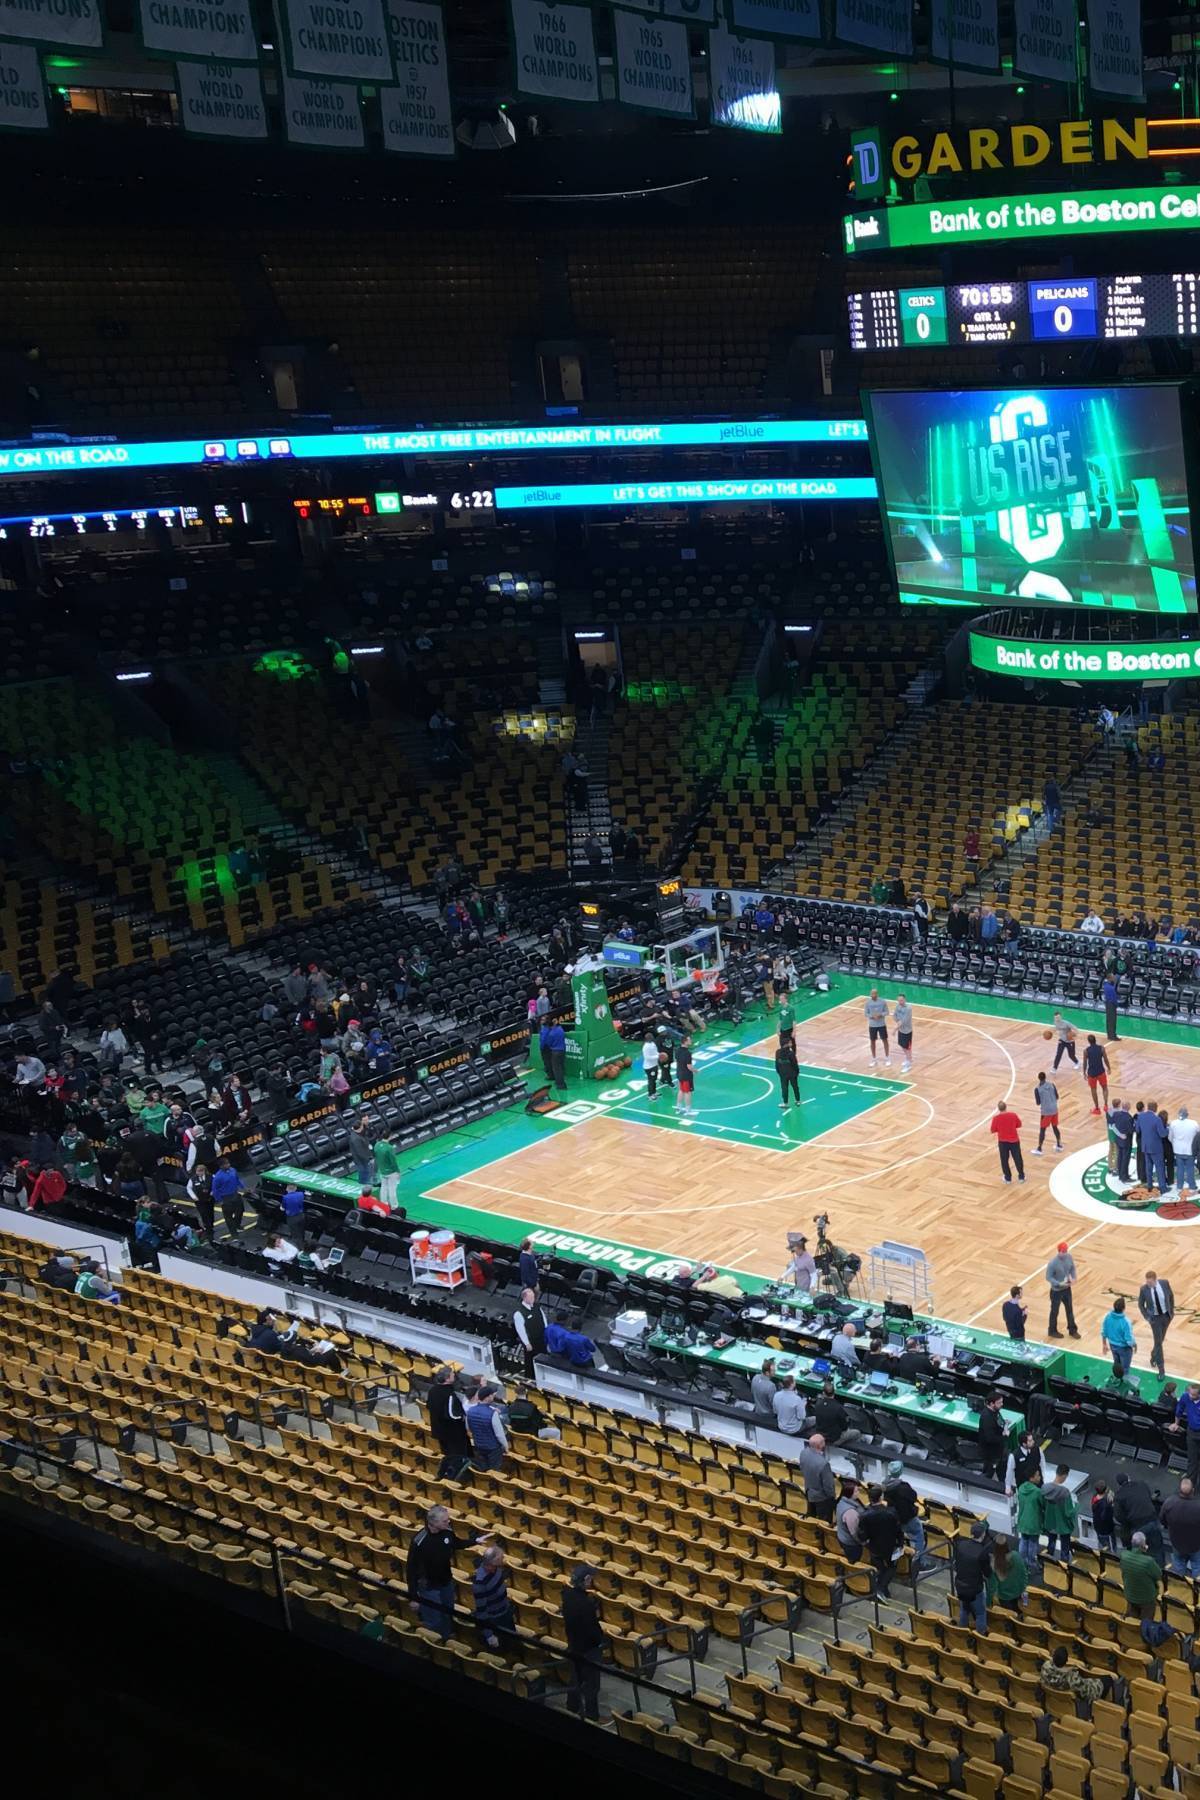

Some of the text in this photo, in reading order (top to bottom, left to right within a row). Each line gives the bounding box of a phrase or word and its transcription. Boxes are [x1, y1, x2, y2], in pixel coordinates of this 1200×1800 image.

[149, 2, 245, 34] CHAMPIONS
[309, 5, 363, 31] WORLD
[391, 14, 439, 42] OSTON
[538, 12, 567, 34] 1966
[1030, 15, 1063, 37] WORLD
[299, 28, 383, 57] CHAMPIONS
[533, 33, 577, 59] WORLD
[640, 28, 663, 49] 1965
[1020, 34, 1073, 62] CHAMPIONS
[1102, 36, 1131, 53] WORLD
[394, 41, 439, 65] ELTICS
[632, 48, 673, 71] WORLD
[521, 55, 593, 83] CHAMPIONS
[1094, 54, 1140, 75] CHAMPIONS
[199, 80, 244, 100] WORLD
[406, 84, 427, 100] 1957
[623, 68, 687, 95] CHAMPIONS
[189, 99, 260, 120] CHAMPIONS
[303, 92, 345, 111] WORLD
[400, 102, 436, 121] WORLD
[292, 110, 358, 131] CHAMPIONS
[388, 119, 449, 139] CHAMPIONS
[891, 118, 1148, 178] GARDEN
[930, 206, 982, 234] Bank
[986, 203, 1010, 230] of
[1015, 202, 1056, 228] the
[1061, 198, 1156, 224] Boston
[908, 296, 935, 308] CELTICS
[959, 286, 1013, 306] 70:55
[1036, 286, 1089, 300] PELICANS
[916, 313, 930, 339] 0
[974, 312, 992, 322] QTR
[986, 322, 1008, 331] FOULS
[1054, 305, 1074, 333] 0
[987, 332, 1006, 341] OUTS
[364, 435, 391, 450] THE
[395, 434, 437, 449] MOST
[442, 432, 475, 447] FREE
[476, 429, 591, 446] ENTERTAINMENT
[594, 429, 611, 443] IN
[719, 424, 765, 440] jetBlue
[828, 421, 860, 437] LET'S
[14, 451, 39, 468] ON
[45, 450, 77, 466] THE
[968, 430, 1078, 507] US RISE
[381, 494, 438, 509] TD Bank
[450, 490, 494, 509] 6:22
[523, 488, 561, 503] jetBlue
[613, 486, 645, 500] LET'S
[647, 485, 675, 499] GET
[676, 484, 704, 498] THIS
[706, 484, 747, 497] SHOW
[751, 483, 775, 496] ON
[776, 482, 799, 495] THE
[131, 511, 148, 519] AST
[30, 525, 55, 538] 2/2
[995, 645, 1037, 670] Bank
[1039, 650, 1060, 671] of
[1063, 651, 1102, 672] the
[1106, 649, 1191, 672] Boston
[491, 1027, 531, 1050] GARDEN
[429, 1052, 471, 1075] GARDEN
[598, 1041, 741, 1102] GAEN
[362, 1077, 407, 1100] GARDEN
[290, 1103, 337, 1129] GARDEN
[526, 1230, 657, 1272] Putnam
